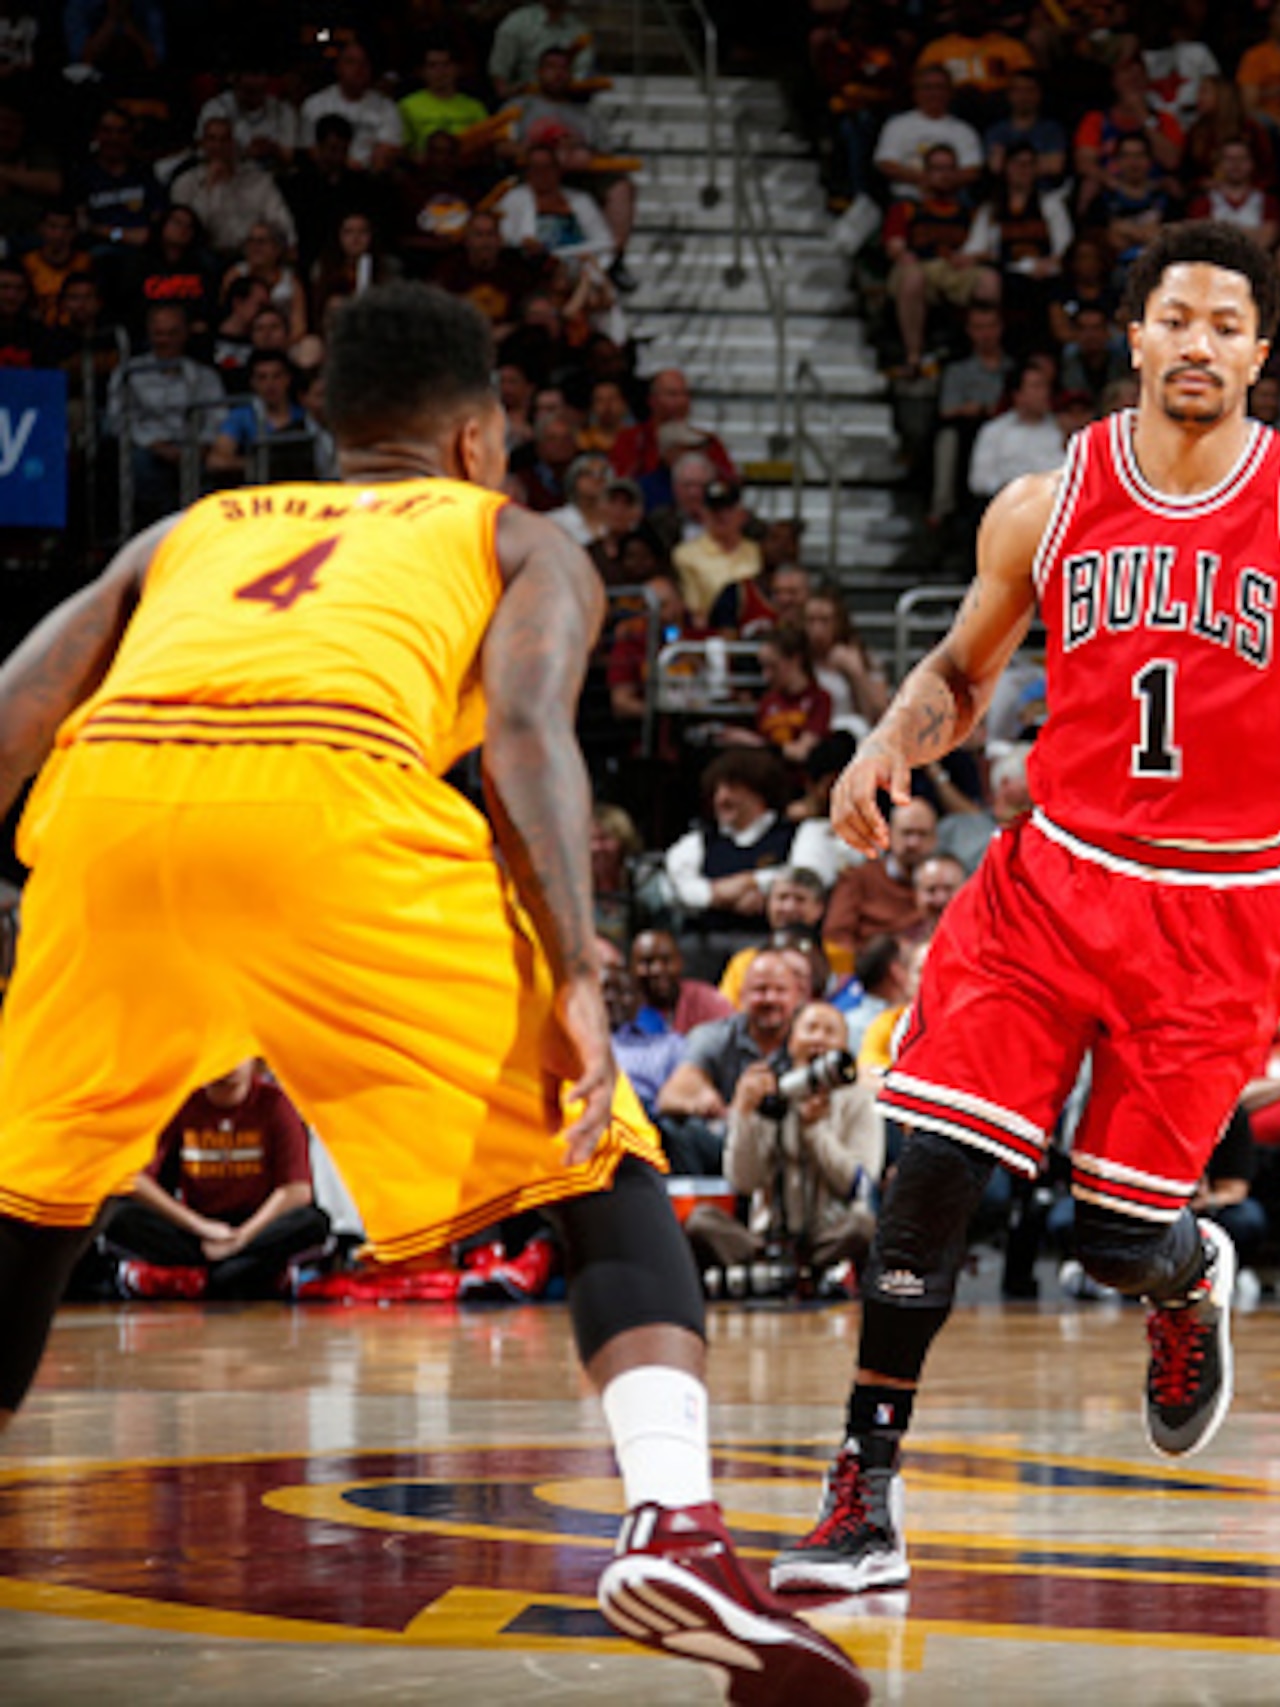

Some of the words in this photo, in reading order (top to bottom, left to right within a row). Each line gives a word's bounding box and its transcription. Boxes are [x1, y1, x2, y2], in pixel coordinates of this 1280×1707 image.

[233, 532, 343, 613] 4
[1063, 546, 1276, 670] BULLS
[1130, 657, 1183, 780] 1
